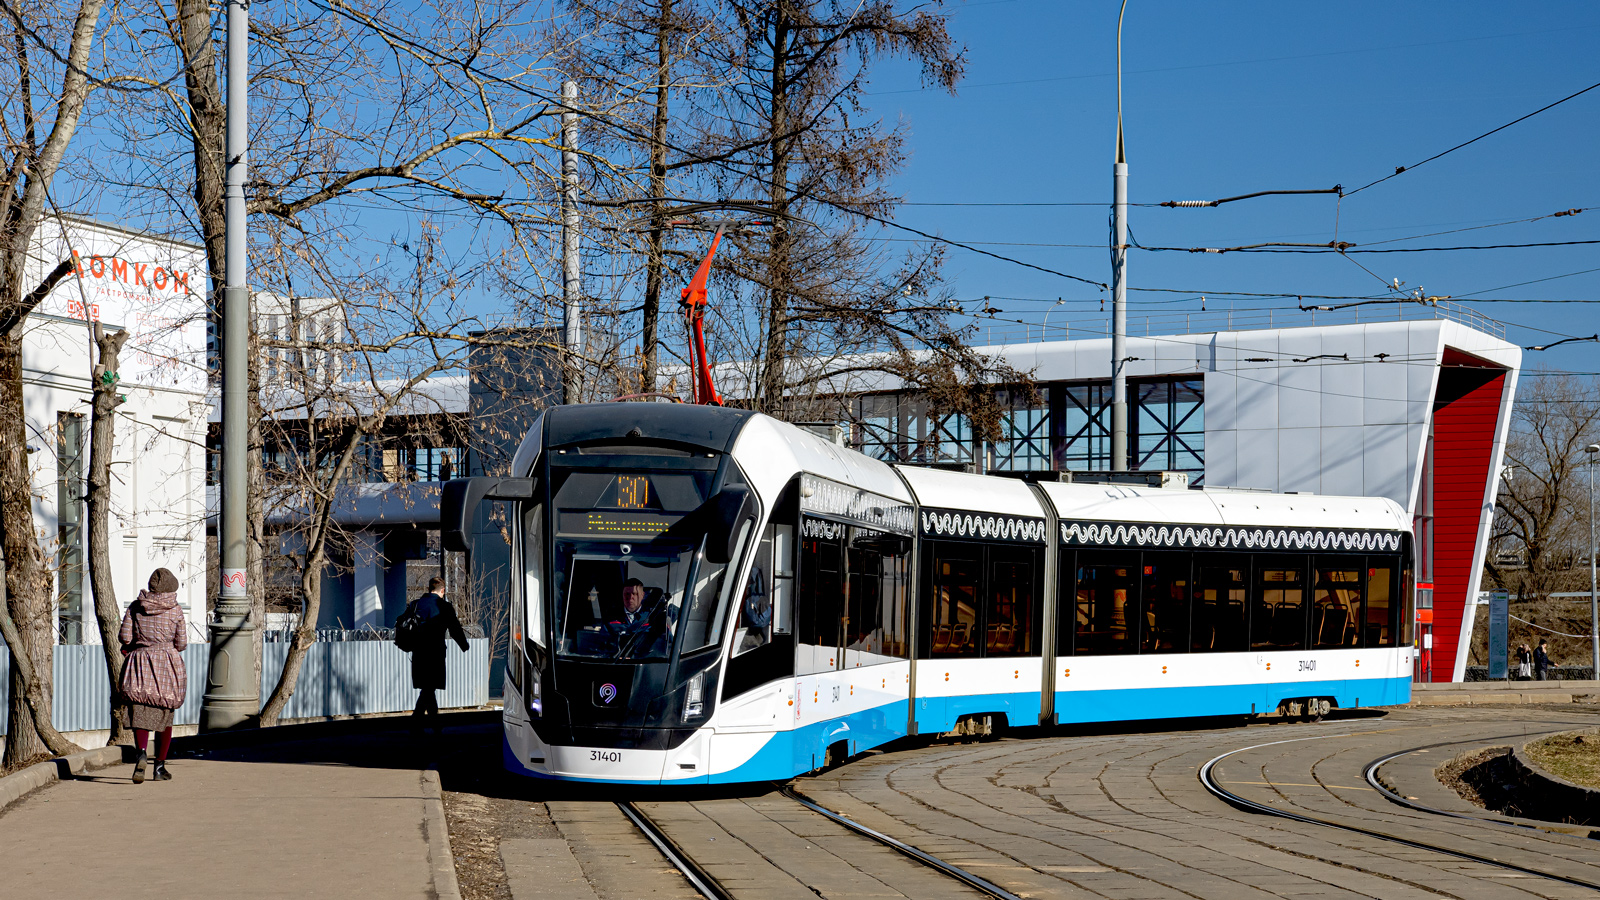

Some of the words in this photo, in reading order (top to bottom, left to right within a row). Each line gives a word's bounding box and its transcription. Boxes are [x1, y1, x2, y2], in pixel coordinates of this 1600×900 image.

[97, 287, 161, 304] ГАСТРОМАРКЕТ
[618, 476, 648, 508] 30
[1298, 660, 1316, 671] 31401
[590, 750, 621, 762] 31401
